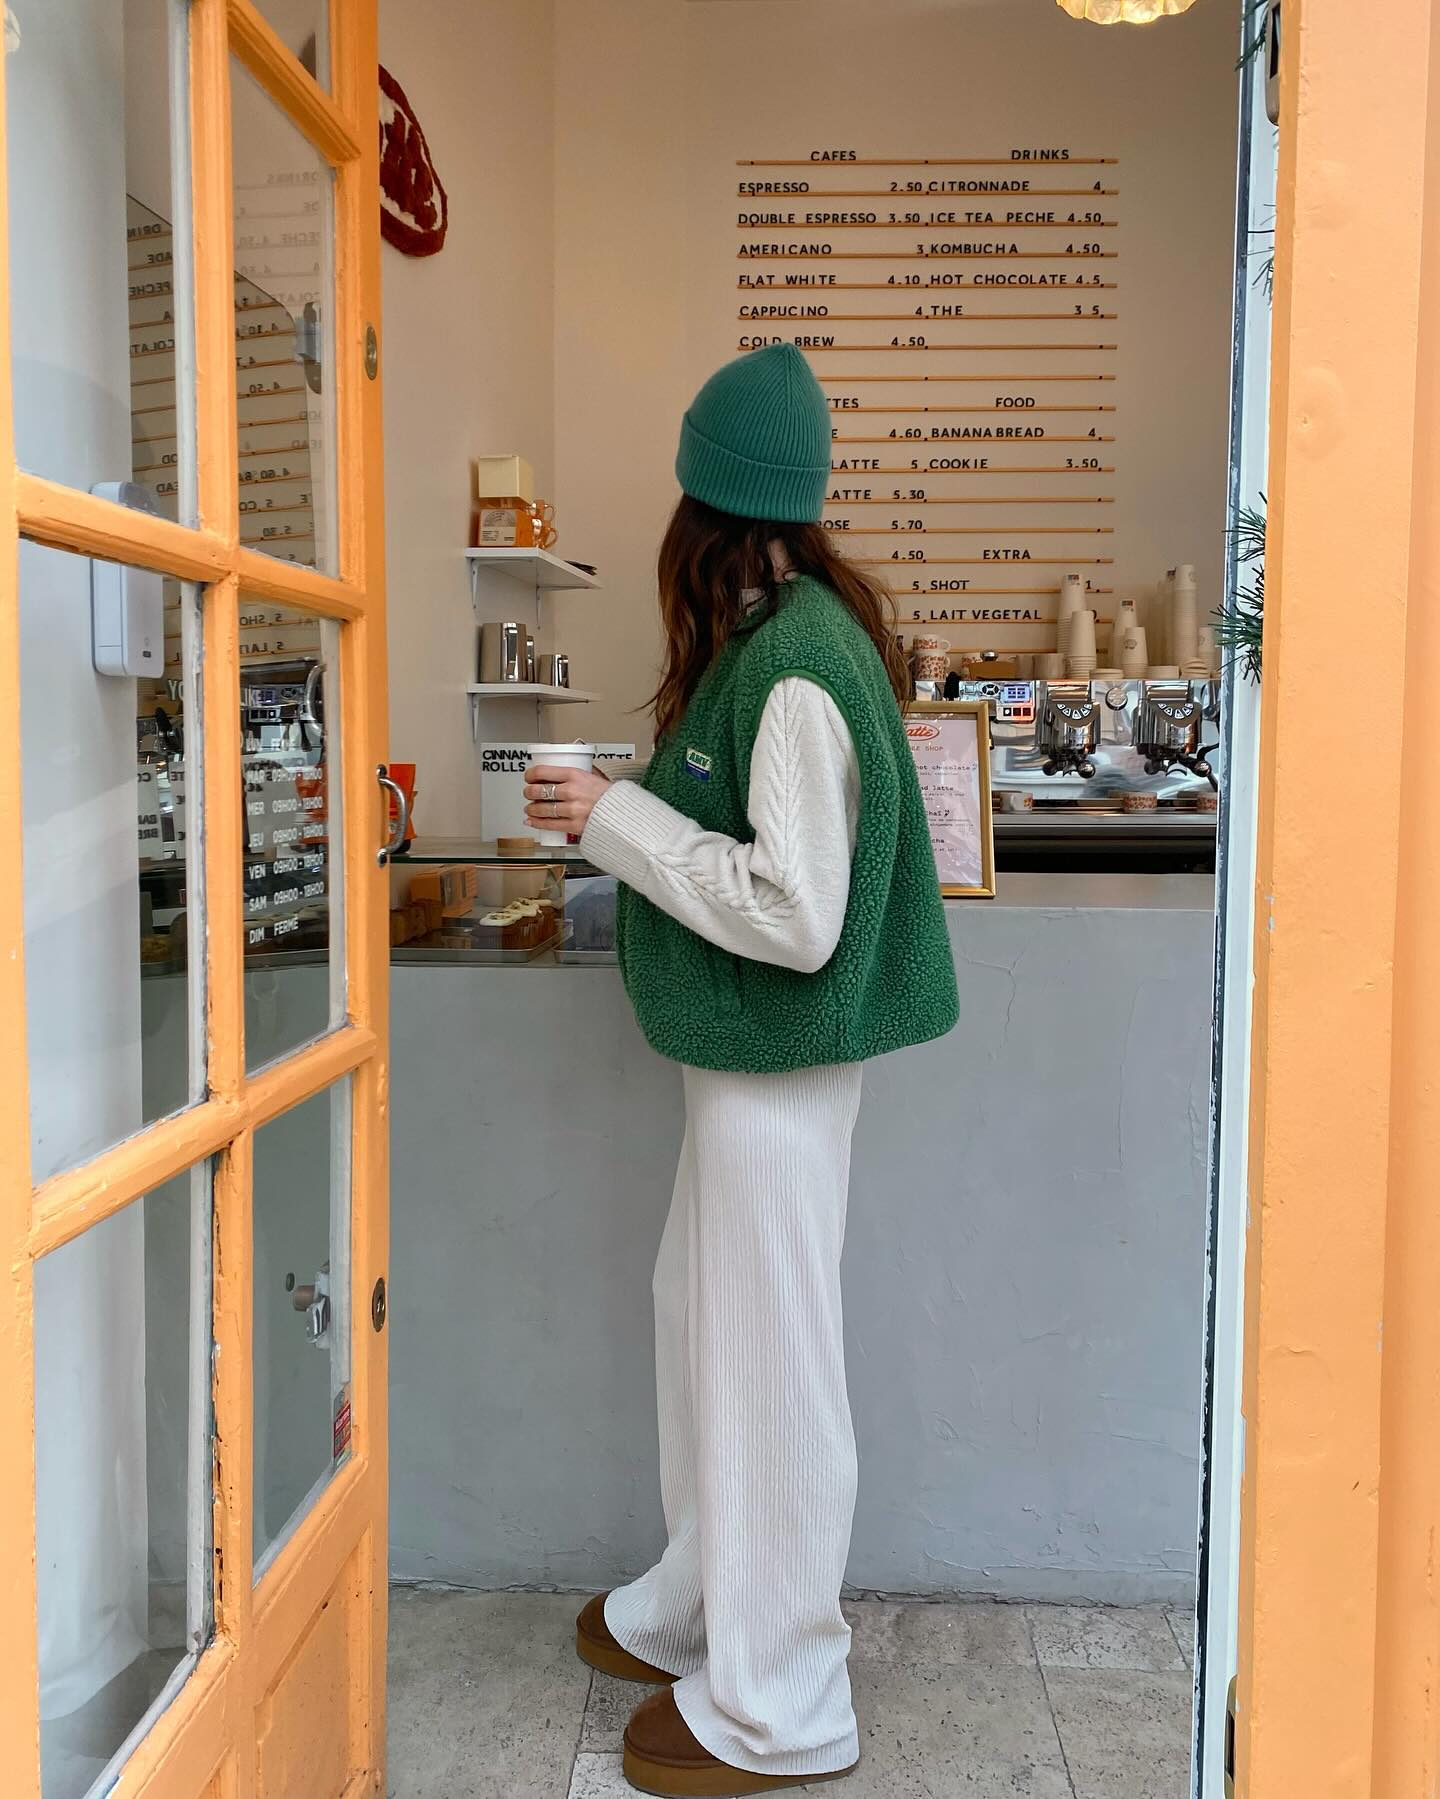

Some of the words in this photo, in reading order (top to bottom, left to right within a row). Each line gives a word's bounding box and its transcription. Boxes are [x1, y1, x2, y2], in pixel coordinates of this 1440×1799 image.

[810, 150, 857, 161] CAFES
[1011, 149, 1070, 160] DRINKS
[739, 182, 810, 193] ESPRESSO
[890, 182, 923, 192] 2.50
[928, 181, 1030, 192] CITRONNADE
[1093, 181, 1101, 191] 4
[738, 213, 796, 224] DOUBLE
[806, 213, 877, 224] ESPRESSO
[888, 213, 921, 223] 3.50
[930, 212, 956, 223] ICE
[965, 212, 993, 223] TEA
[1006, 212, 1055, 223] PECHE
[1067, 212, 1102, 223] 4.50
[739, 244, 833, 255] AMERICANO
[917, 244, 924, 255] 3
[930, 243, 1019, 254] KOMBUCHA
[1065, 243, 1101, 254] 4.50
[739, 275, 776, 286] FLAT
[785, 275, 837, 285] WHITE
[888, 275, 921, 285] 4.10
[930, 274, 964, 285] HOT
[973, 274, 1067, 285] CHOCOLATE
[739, 306, 829, 317] CAPPUCINO
[915, 306, 923, 316] 4
[930, 306, 964, 316] THE
[795, 336, 835, 347] BREW
[891, 336, 926, 347] 4.50
[995, 397, 1036, 408] FOOD
[889, 428, 922, 438] 4.60
[1088, 428, 1096, 437] 4
[911, 459, 919, 469] 5
[929, 458, 989, 469] COOKIE
[1066, 458, 1099, 469] 3.50
[824, 489, 872, 500] ATTE
[893, 489, 925, 500] 5.30
[891, 520, 923, 530] 5.70
[891, 550, 924, 560] 4.50
[983, 549, 1032, 560] EXTRA
[912, 581, 920, 591] 5
[930, 580, 970, 591] SHOT
[913, 610, 921, 620] 5
[930, 610, 967, 620] LAIT
[972, 610, 1043, 620] VEGETAL
[482, 762, 525, 772] ROLLS
[248, 863, 267, 880] VEN
[273, 859, 299, 874] 09H00
[249, 895, 268, 912] SAM
[274, 888, 299, 905] 09H00
[249, 926, 265, 944] DIM
